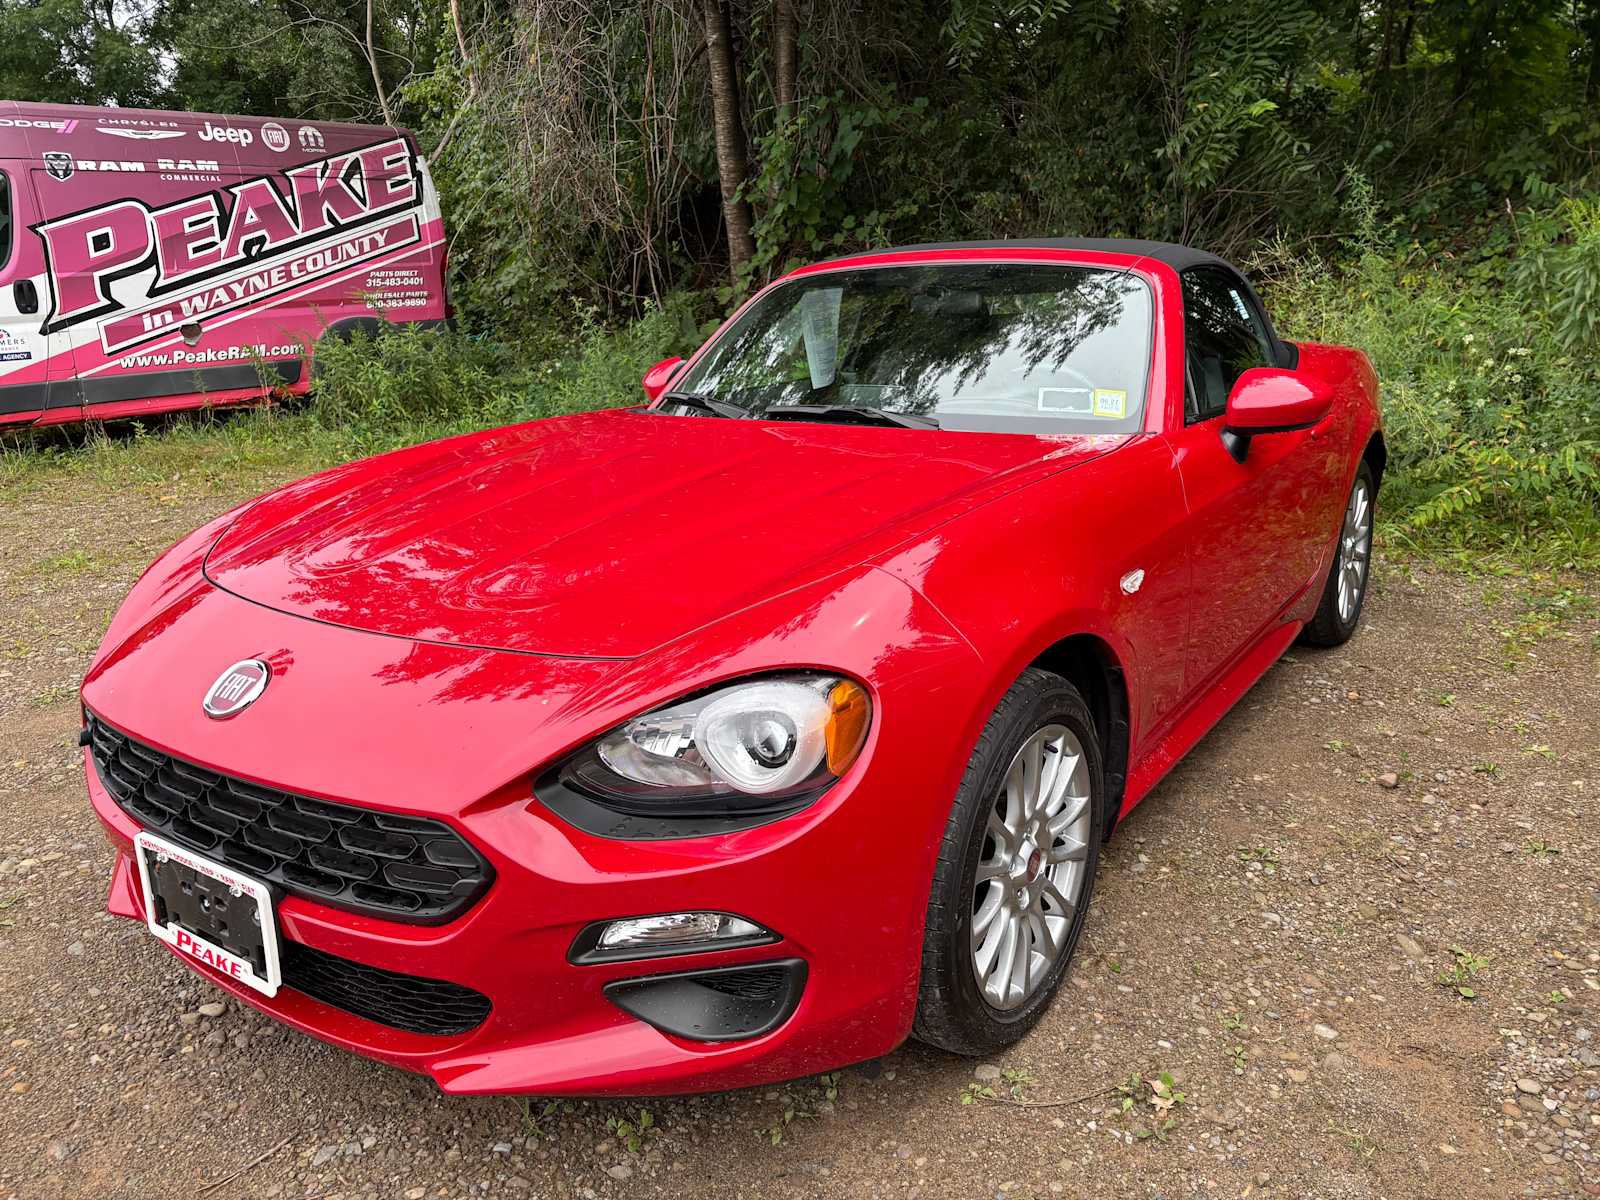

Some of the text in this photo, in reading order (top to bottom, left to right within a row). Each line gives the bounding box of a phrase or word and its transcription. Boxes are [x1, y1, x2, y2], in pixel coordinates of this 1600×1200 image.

[97, 118, 179, 128] CHRYSLER
[198, 121, 254, 147] Jeep
[267, 129, 284, 144] FIAT
[76, 160, 146, 172] RAM
[157, 158, 220, 172] RAM
[160, 174, 222, 182] COMMERCIAL
[28, 136, 424, 336] PEAKE
[142, 229, 390, 331] in WAYNE COUNTY
[366, 277, 424, 287] 315-483-0401
[2, 353, 28, 361] AGENCY
[214, 672, 257, 702] FIAT
[176, 929, 242, 979] PEAKE
